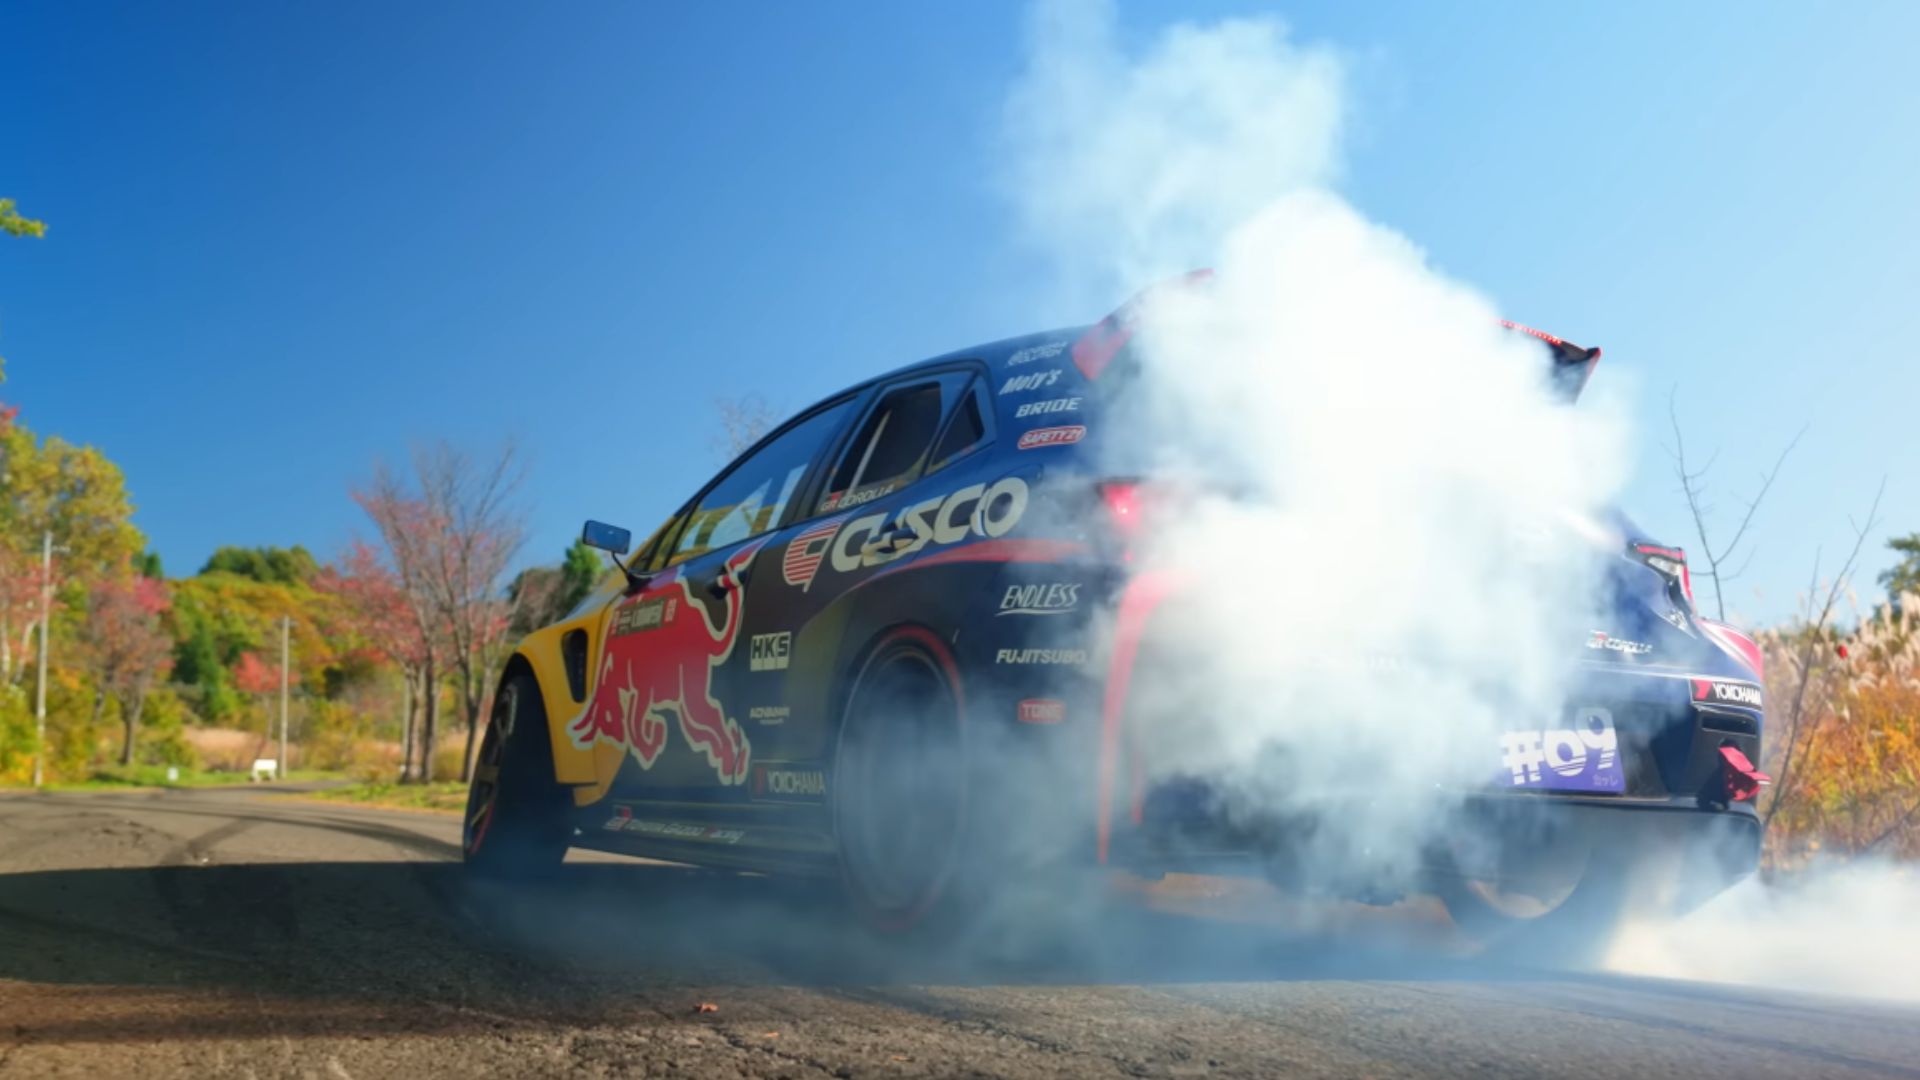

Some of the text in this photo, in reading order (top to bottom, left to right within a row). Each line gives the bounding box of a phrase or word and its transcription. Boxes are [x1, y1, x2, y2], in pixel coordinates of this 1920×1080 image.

[1015, 397, 1083, 418] BRIDE
[1000, 583, 1082, 609] ENDLESS
[752, 635, 790, 659] HKS
[996, 649, 1087, 664] FUJITSUBO
[767, 770, 826, 794] YOKOHAMA
